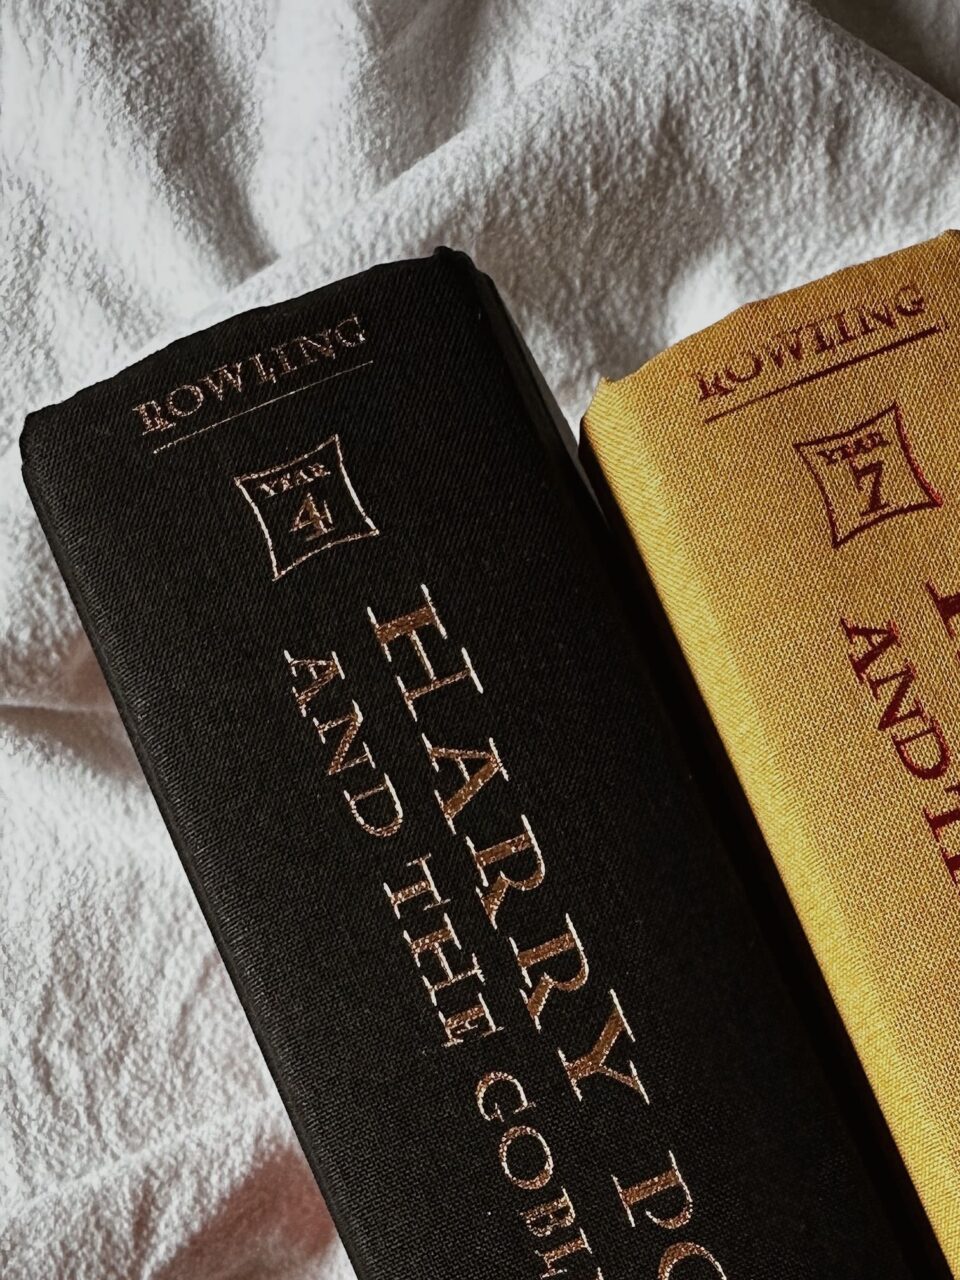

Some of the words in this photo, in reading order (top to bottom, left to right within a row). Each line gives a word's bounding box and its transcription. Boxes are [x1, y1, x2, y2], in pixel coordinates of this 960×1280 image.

[132, 313, 366, 436] ROWLING
[692, 284, 926, 400] ROWLING
[817, 431, 892, 466] YEAR
[850, 460, 891, 517] 7
[289, 492, 336, 541] 4
[840, 618, 951, 780] AND
[284, 650, 404, 838] AND
[383, 853, 505, 1047] THE
[366, 584, 650, 1104] HARRY
